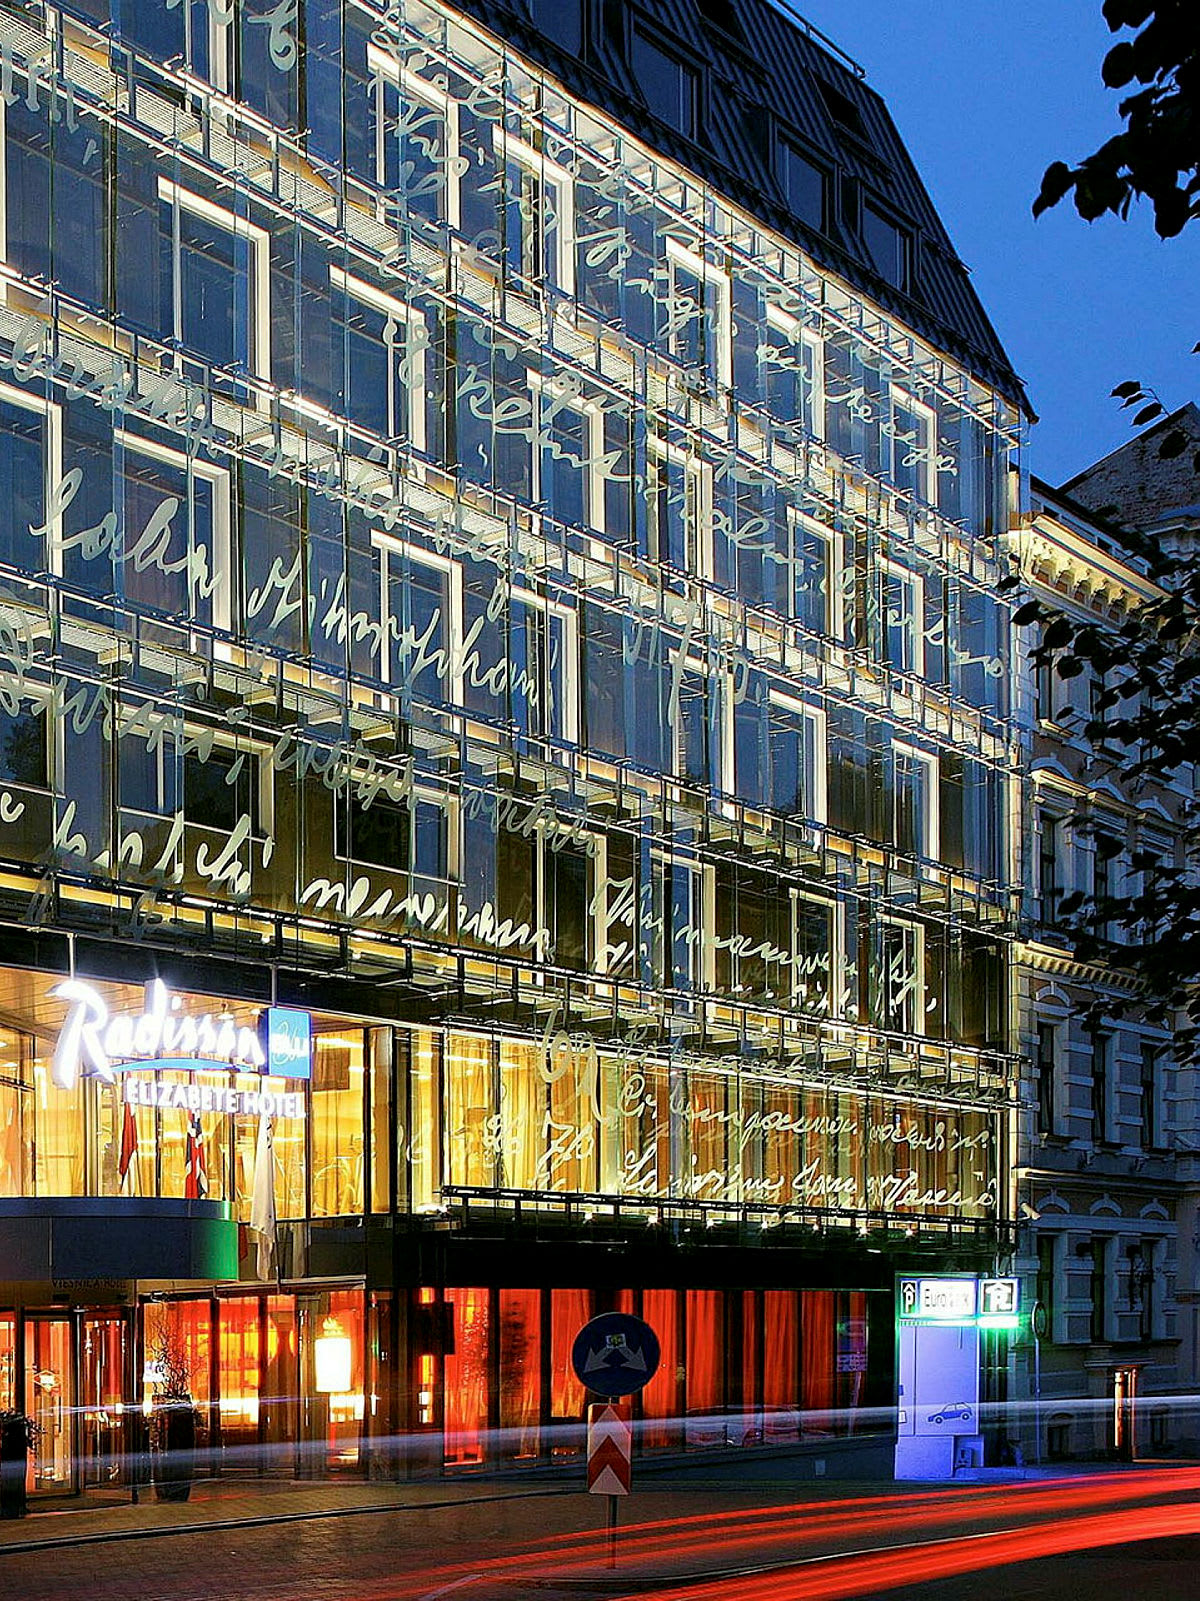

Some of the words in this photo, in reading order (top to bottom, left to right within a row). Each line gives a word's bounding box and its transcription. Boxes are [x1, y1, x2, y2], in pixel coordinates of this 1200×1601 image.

[46, 977, 267, 1089] Radisson
[126, 1076, 238, 1114] ELIZABETE
[242, 1090, 307, 1118] HOTEL
